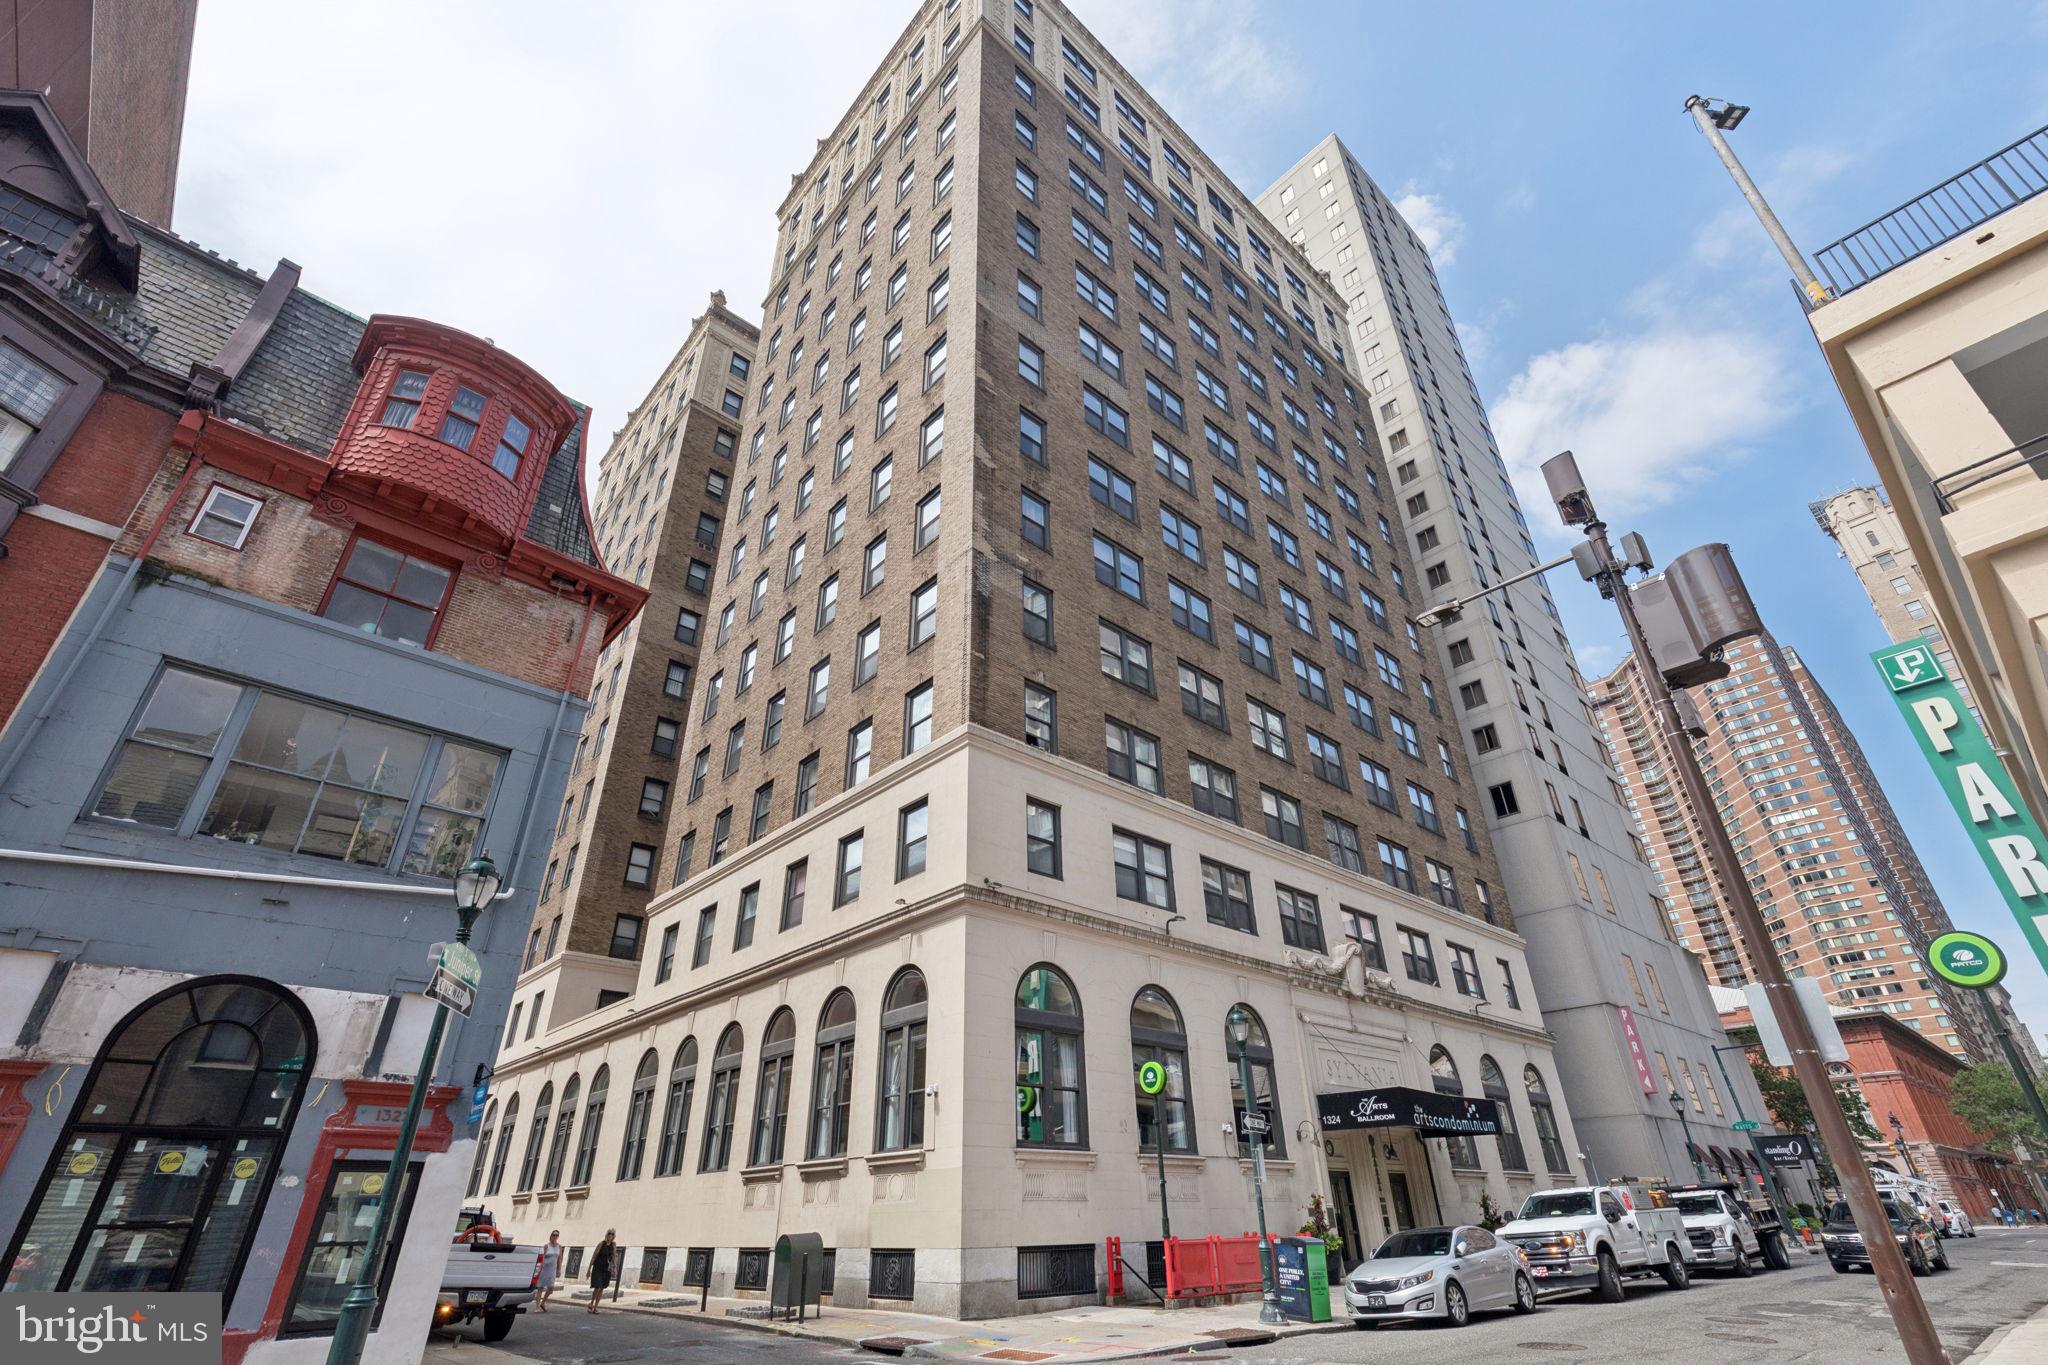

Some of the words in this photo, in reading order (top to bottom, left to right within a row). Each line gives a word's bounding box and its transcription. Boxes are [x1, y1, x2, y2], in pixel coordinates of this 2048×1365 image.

[1911, 697, 2048, 946] PAR
[448, 951, 474, 980] Juniper
[1950, 959, 1983, 968] PATCO
[439, 979, 452, 996] ONE
[452, 986, 465, 1003] WAY
[1621, 1009, 1646, 1072] PARK
[1357, 1113, 1396, 1123] BALLROOM
[1413, 1104, 1424, 1113] the
[1322, 1115, 1341, 1124] 1324
[1413, 1112, 1496, 1132] artscondominium
